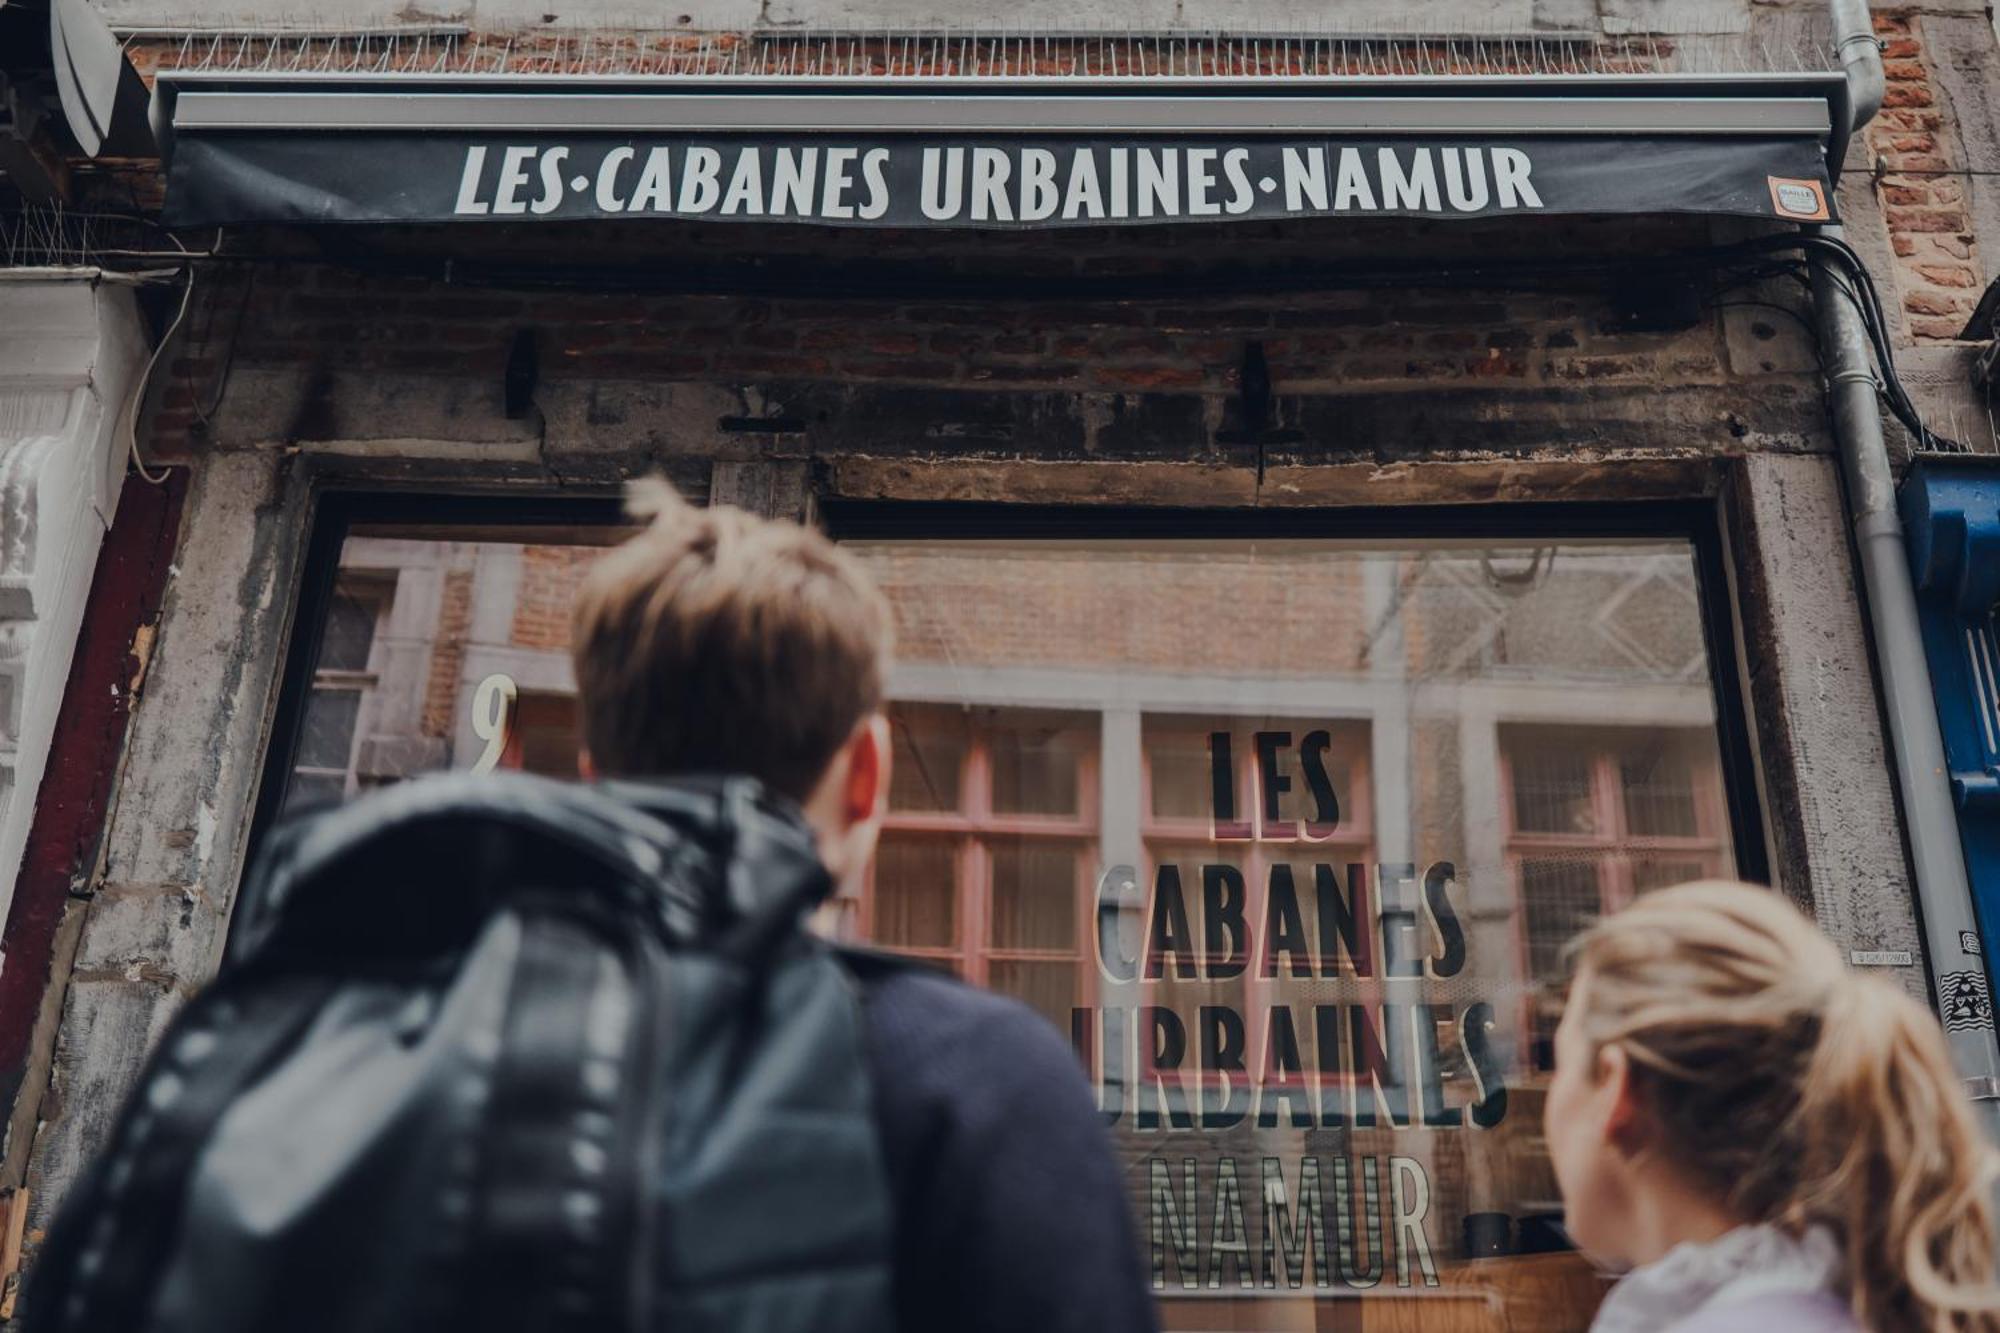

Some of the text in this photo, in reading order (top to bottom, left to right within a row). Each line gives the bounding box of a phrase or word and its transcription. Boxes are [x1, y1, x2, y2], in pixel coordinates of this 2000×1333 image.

[470, 673, 518, 776] 9
[1209, 730, 1340, 842] LES
[1094, 861, 1467, 984] CABANES
[1149, 1156, 1440, 1290] NAMUR
